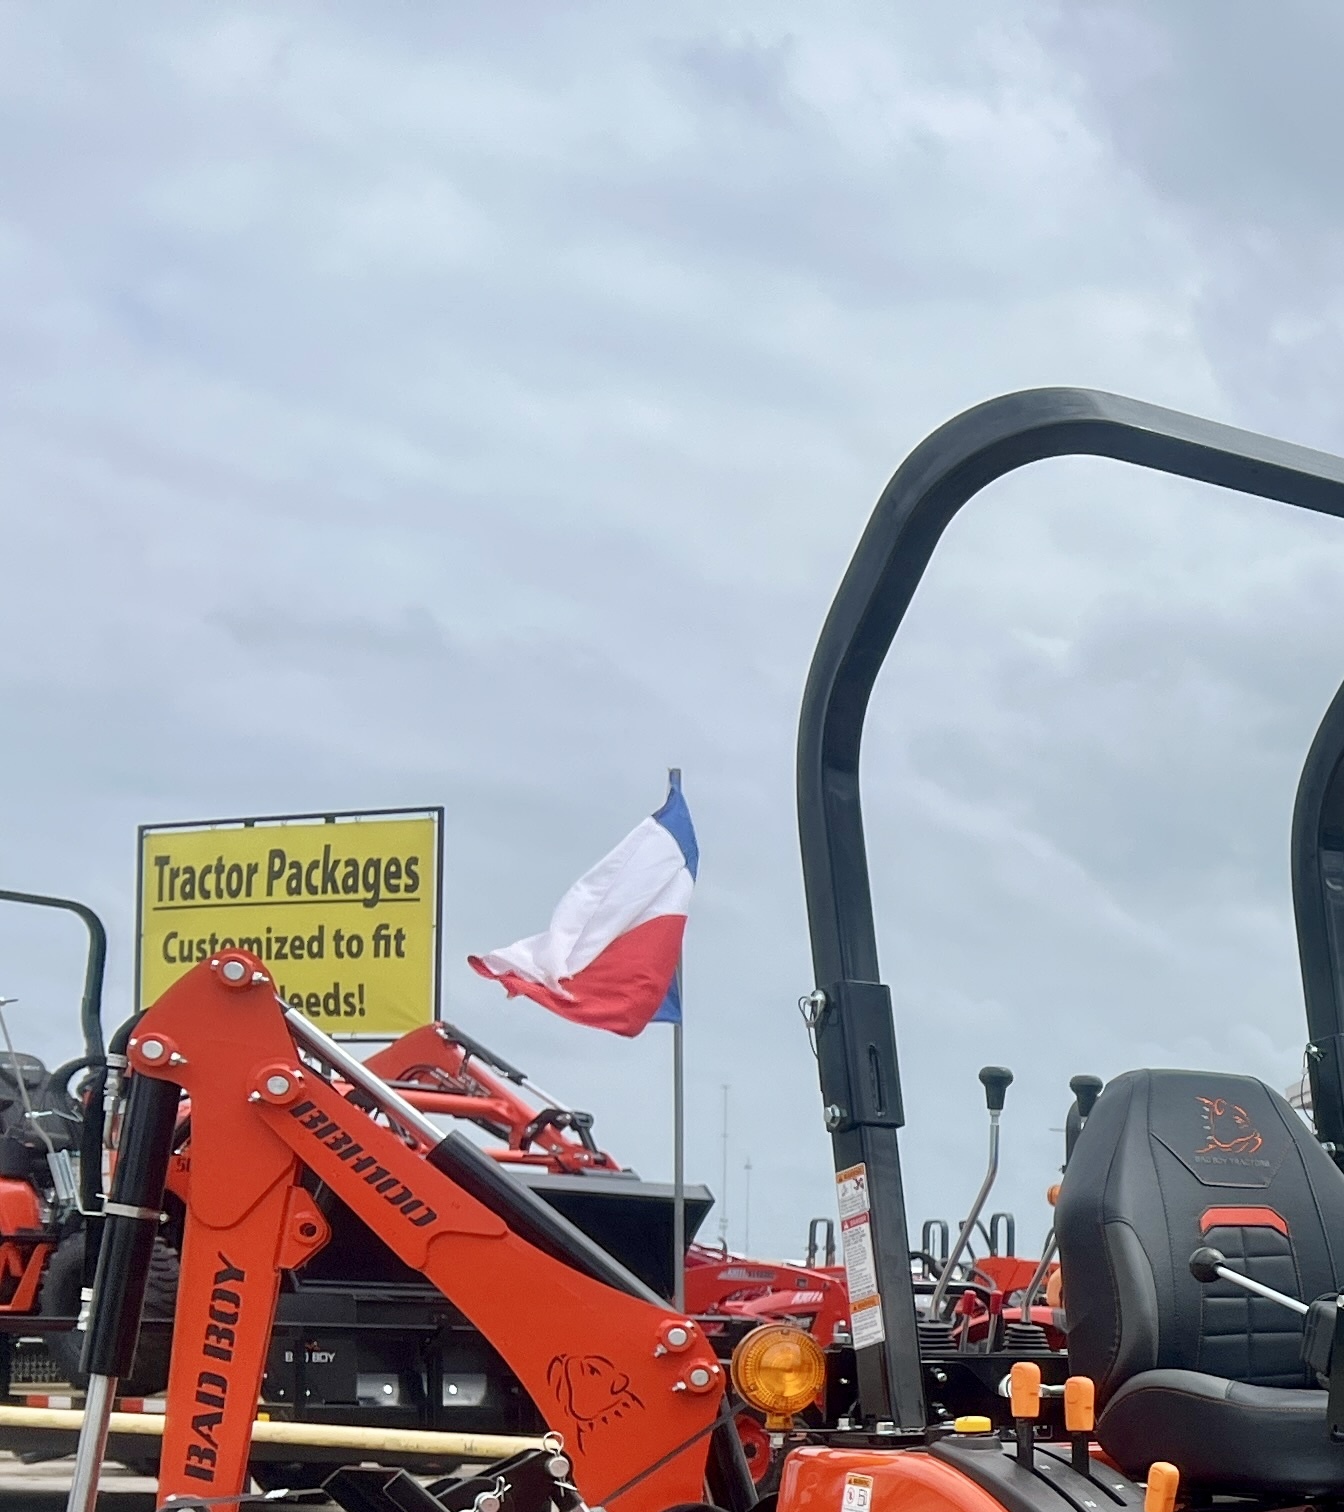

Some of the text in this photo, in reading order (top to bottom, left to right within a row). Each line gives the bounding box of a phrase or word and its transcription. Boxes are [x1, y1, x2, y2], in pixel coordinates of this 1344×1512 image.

[154, 844, 421, 908] Tractor Packages
[333, 927, 365, 959] to
[372, 923, 407, 959] fit
[286, 1100, 440, 1228] BBH100
[184, 1250, 247, 1483] BAD BOY
[312, 1351, 336, 1363] BOY
